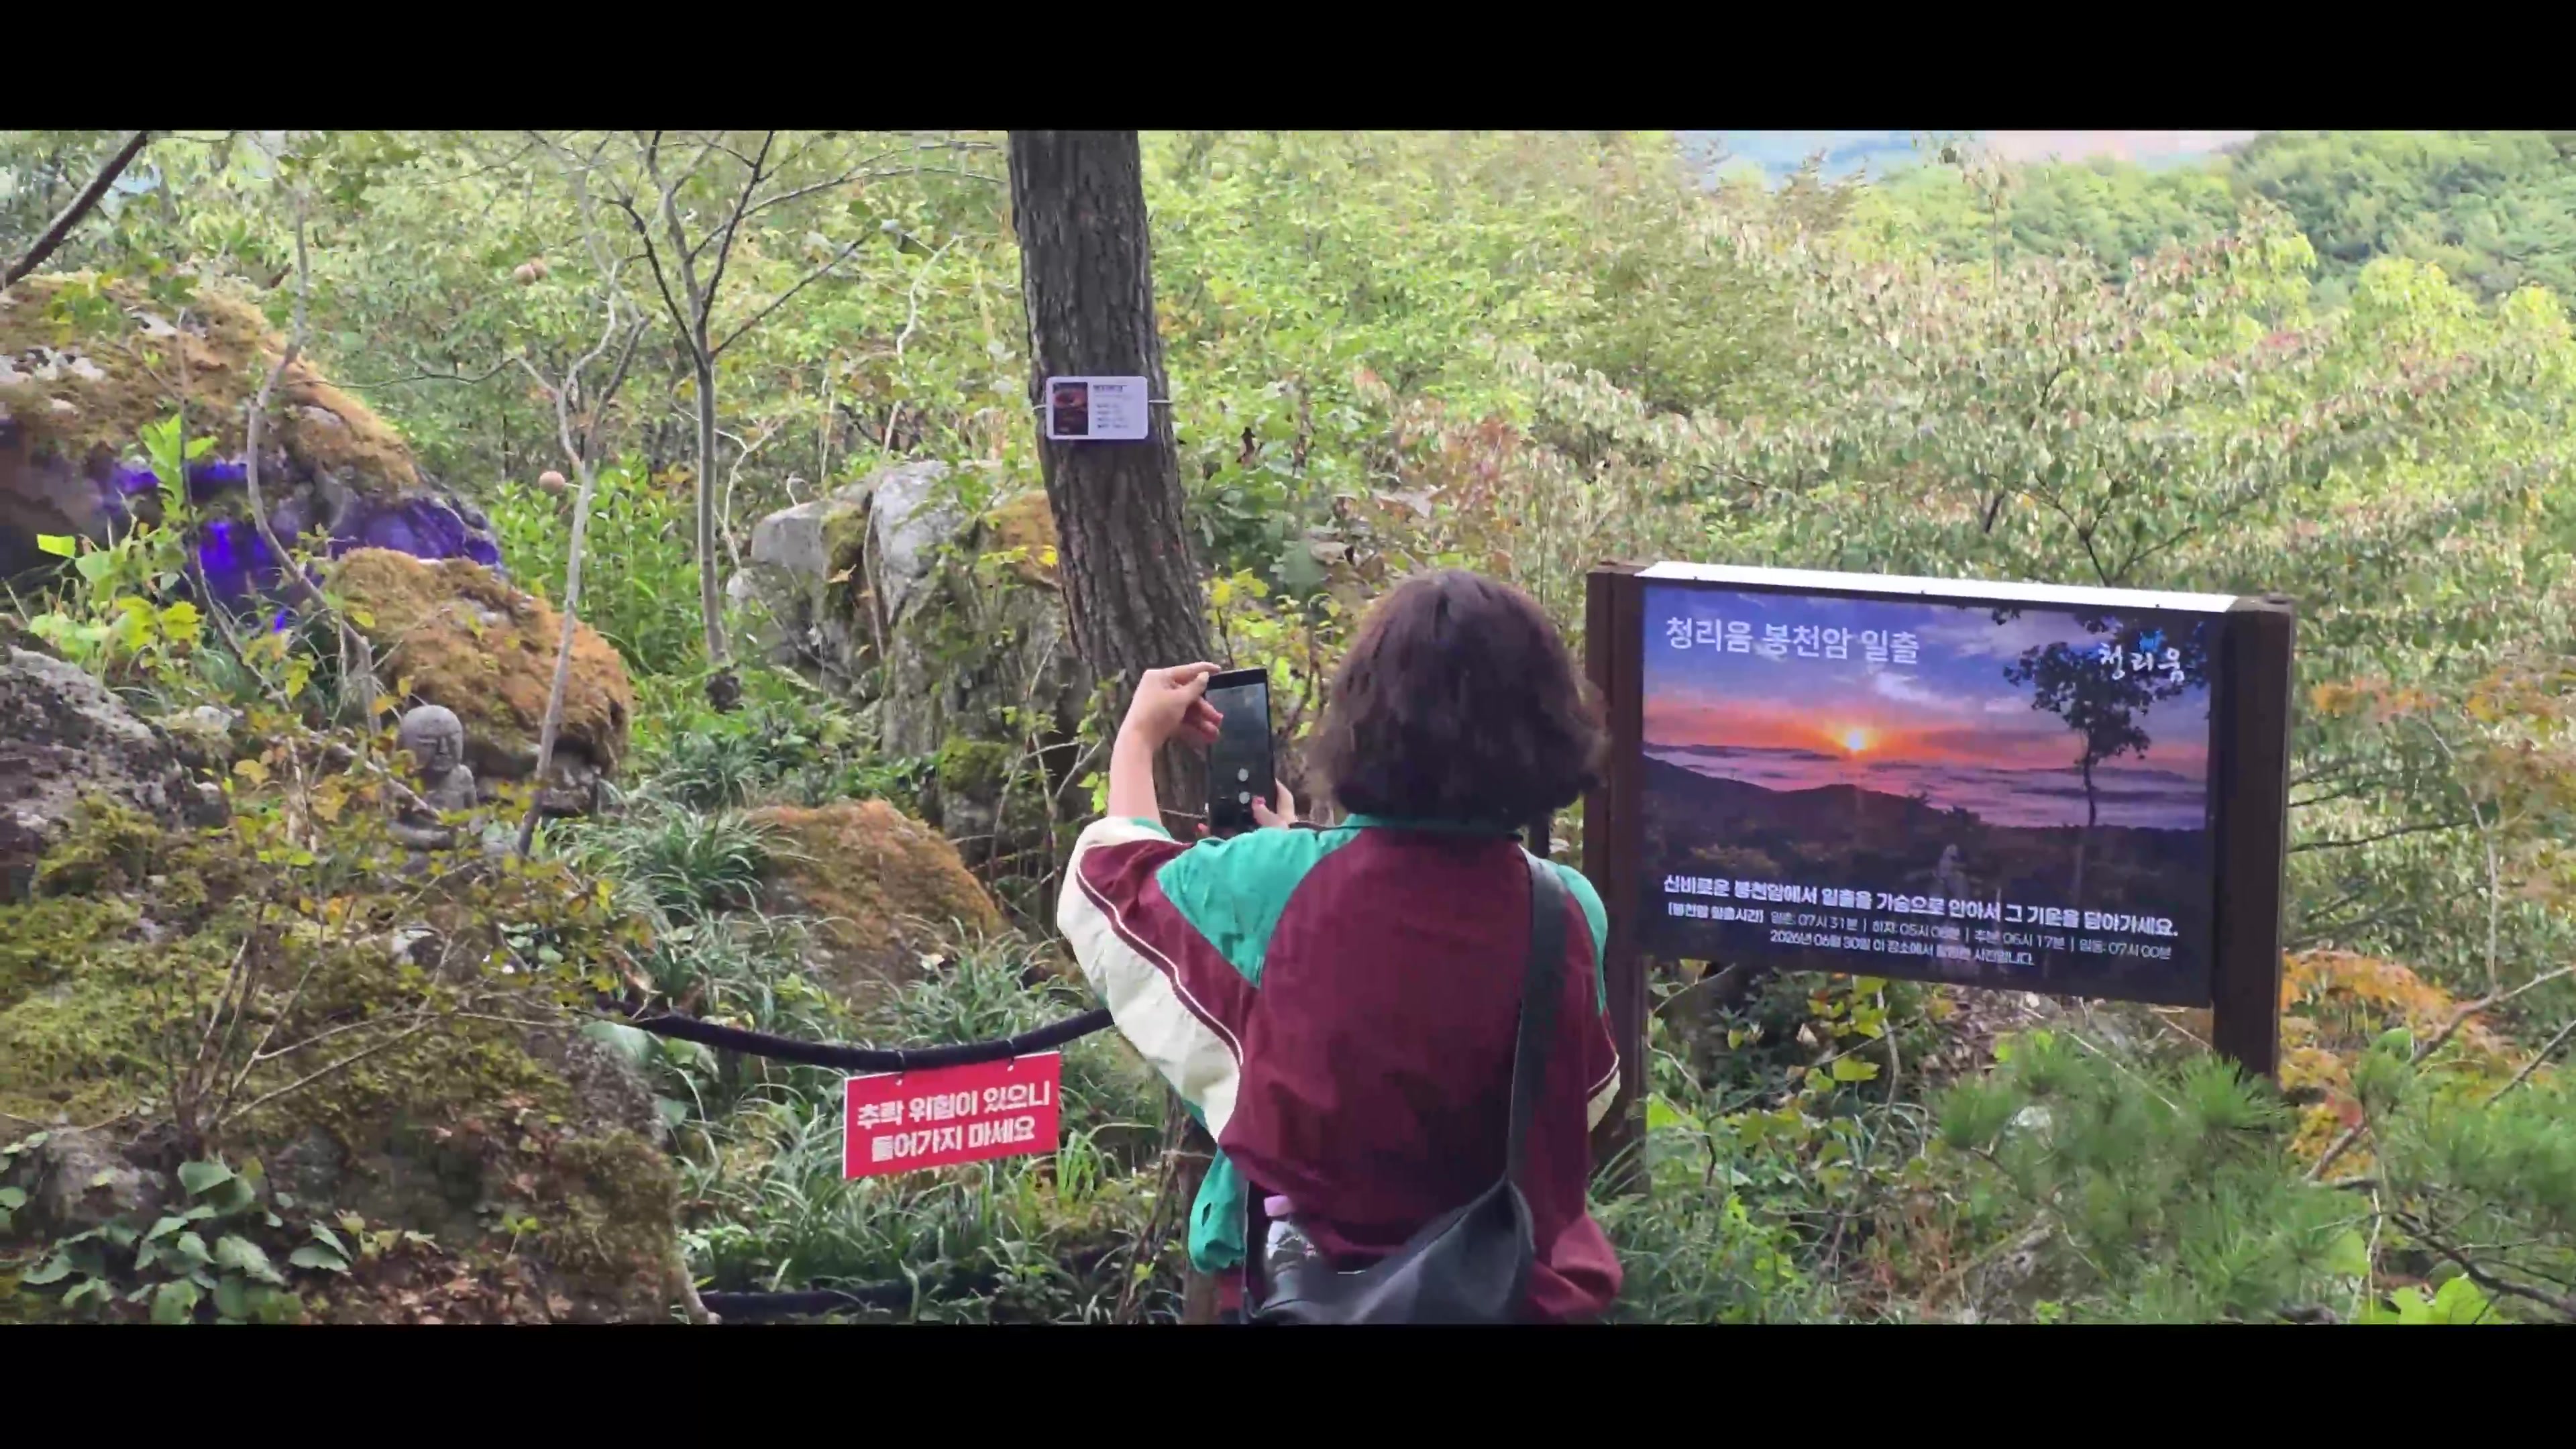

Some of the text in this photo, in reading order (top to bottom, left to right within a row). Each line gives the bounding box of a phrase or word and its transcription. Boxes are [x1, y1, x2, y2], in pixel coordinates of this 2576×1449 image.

[1762, 623, 1854, 659] 봉천암
[1861, 630, 1919, 664] 일출
[1664, 875, 2178, 936] 신비로운 봉천암에서 일출을 가슴으로 안아서 그 기운을 담아가세요.
[1873, 938, 1884, 952] 이
[1887, 939, 1933, 957] 장소에서
[857, 1080, 1051, 1129] 추락 위험이 있으니
[872, 1116, 1035, 1163] 들어가지 마세요
